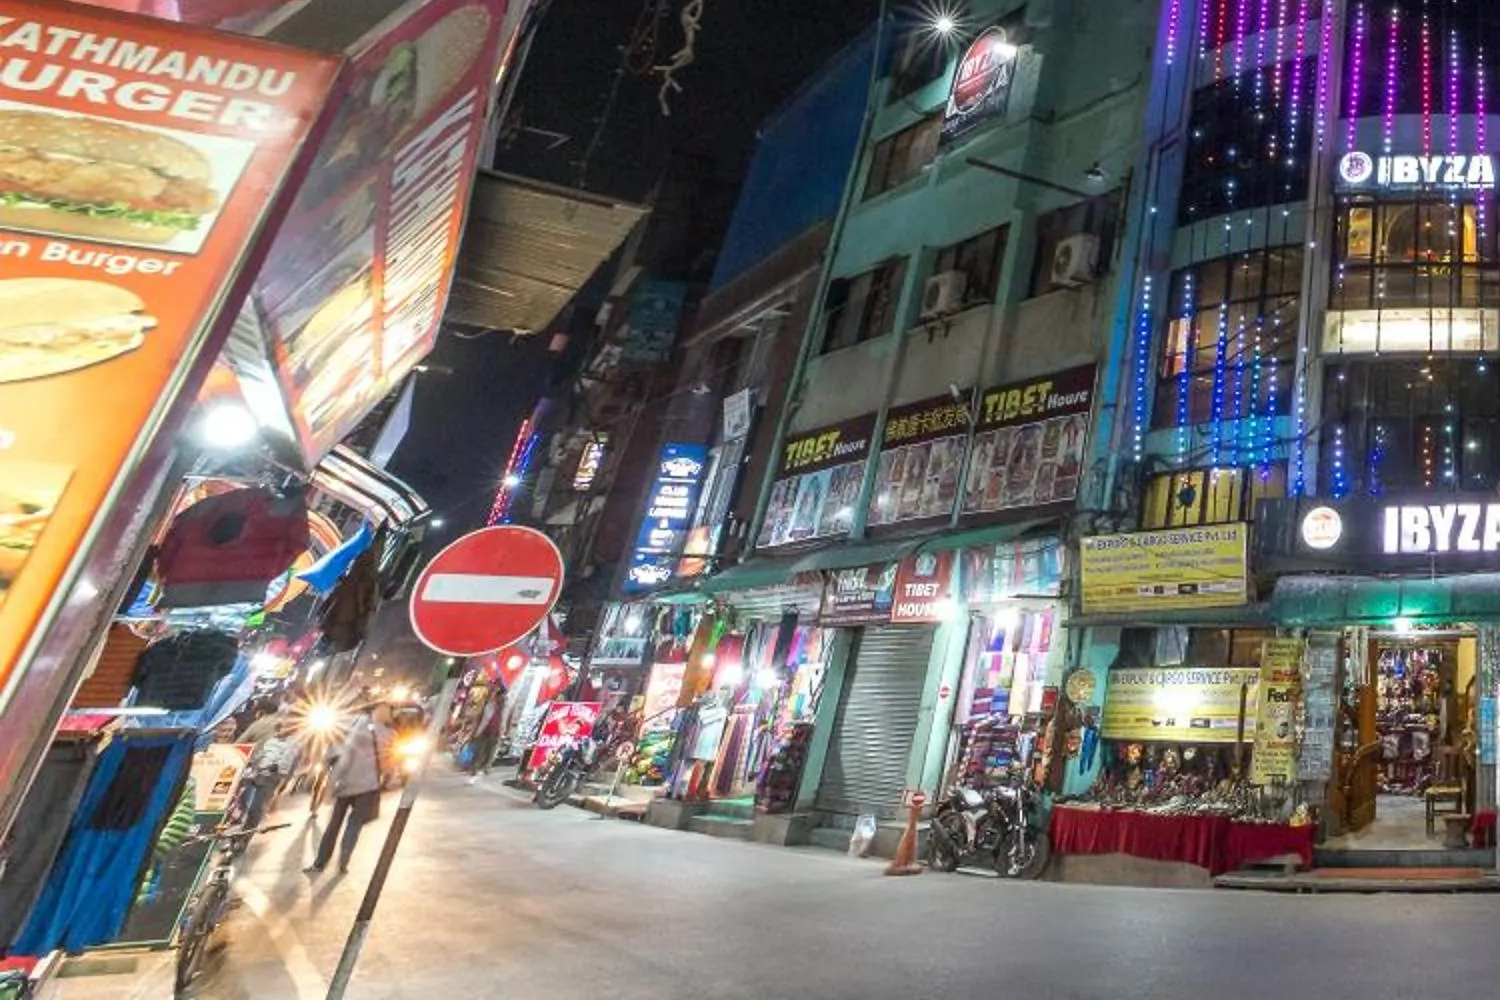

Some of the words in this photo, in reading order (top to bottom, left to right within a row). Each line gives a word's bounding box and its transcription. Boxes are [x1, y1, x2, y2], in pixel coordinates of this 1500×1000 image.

[0, 58, 275, 132] URGER
[1377, 155, 1495, 185] IBYZA
[41, 242, 184, 276] Burger
[984, 381, 1053, 423] TIBET
[1047, 390, 1089, 408] House
[785, 431, 841, 470] TIBET
[905, 583, 940, 597] TIBET
